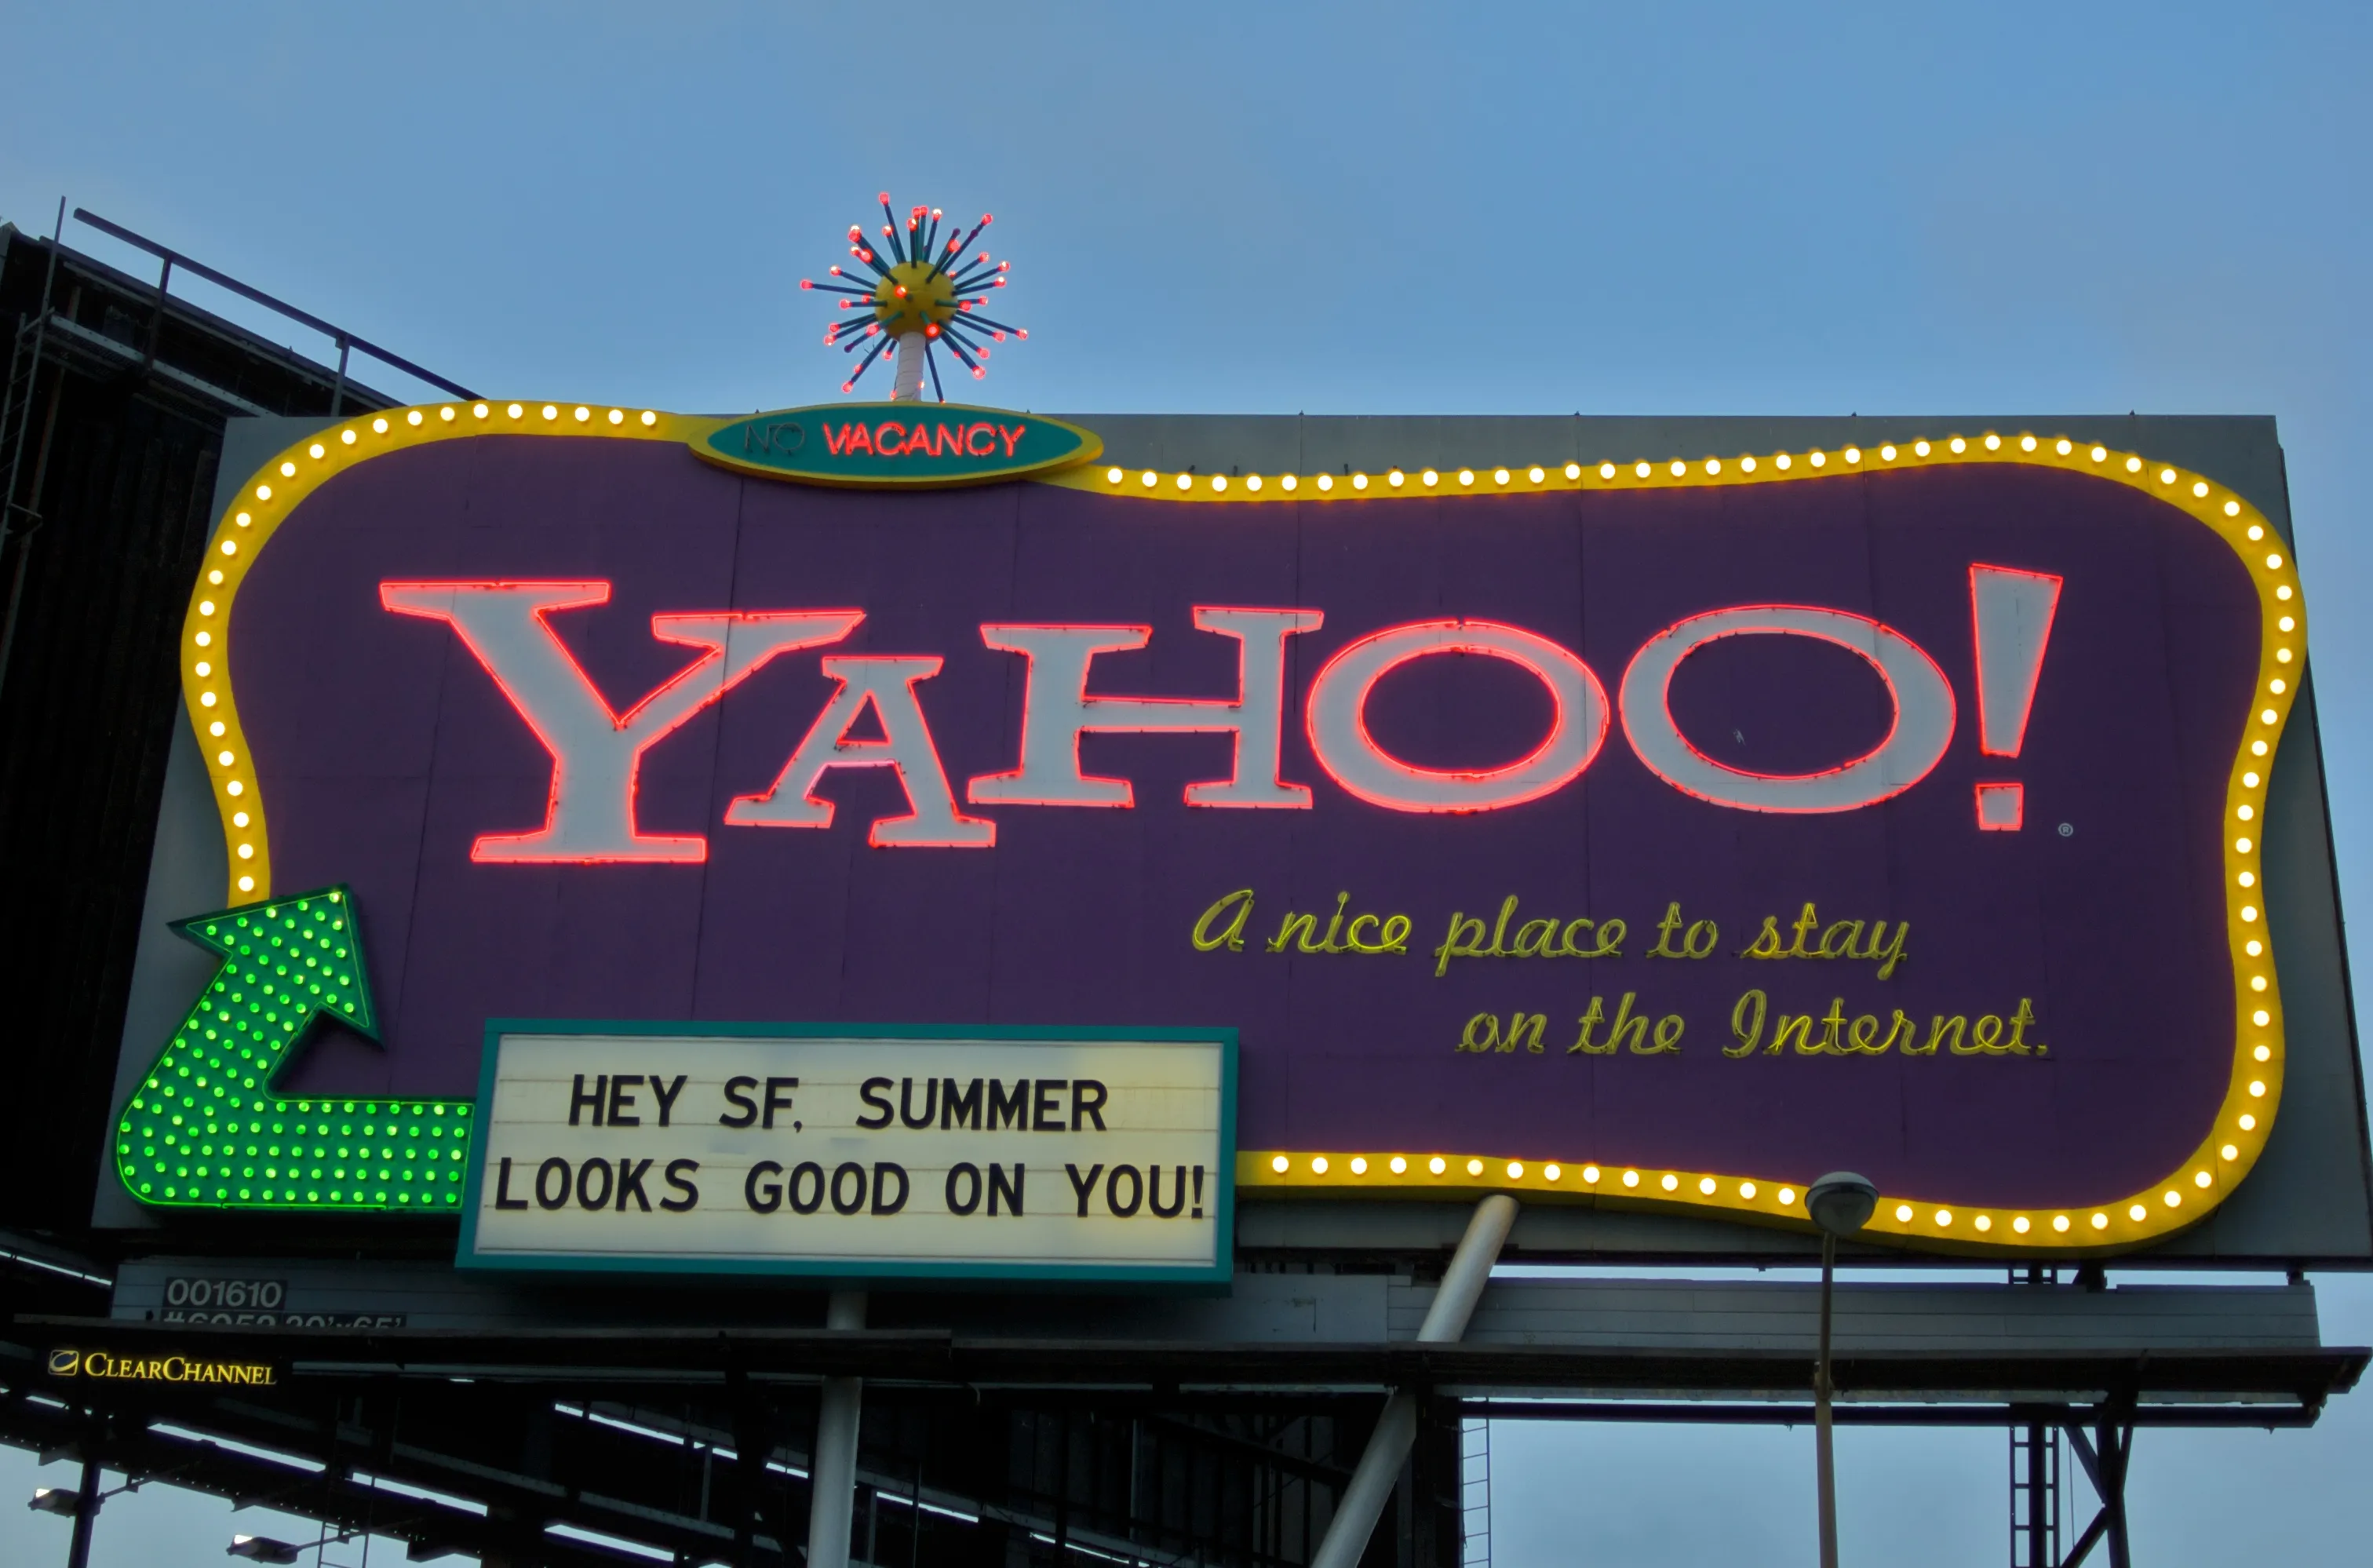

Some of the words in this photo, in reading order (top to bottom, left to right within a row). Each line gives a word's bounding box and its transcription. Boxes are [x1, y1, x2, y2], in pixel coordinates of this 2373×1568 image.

[744, 422, 805, 457] NO
[822, 421, 1026, 457] VACANCY
[380, 563, 2063, 865] YAHOO!
[1192, 889, 1254, 951] A
[1265, 892, 1412, 956] nice
[1433, 895, 1627, 978] place
[1646, 902, 1719, 959] to
[1734, 902, 1910, 980] stay
[1454, 1012, 1549, 1055] on
[1566, 992, 1686, 1056] the
[1722, 989, 2050, 1059] Internet.
[567, 1074, 689, 1128] HEY
[718, 1075, 804, 1133] SF,
[855, 1076, 1109, 1132] SUMMER
[494, 1156, 701, 1212] LOOKS
[744, 1159, 910, 1216] GOOD
[944, 1161, 1026, 1217] ON
[1064, 1163, 1205, 1220] YOU!
[167, 1278, 282, 1308] 001610
